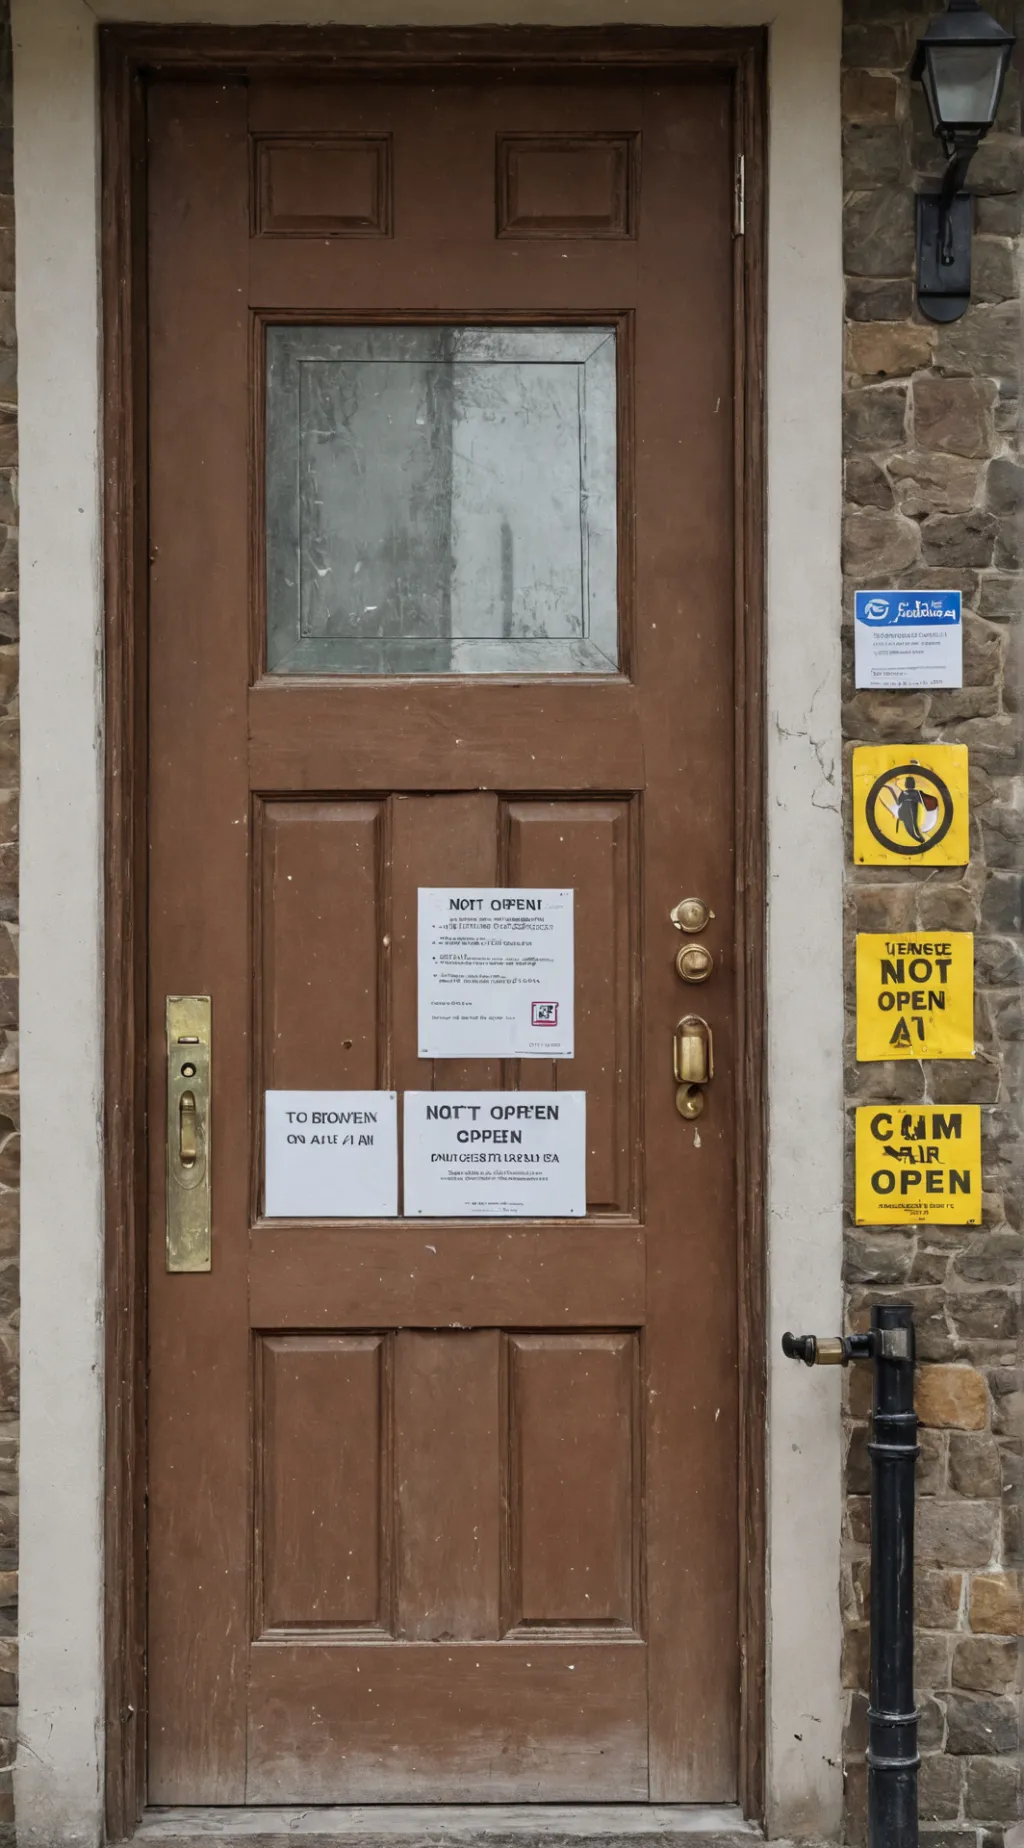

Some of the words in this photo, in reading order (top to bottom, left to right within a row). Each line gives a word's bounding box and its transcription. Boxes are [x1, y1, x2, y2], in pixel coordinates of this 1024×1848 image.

[880, 959, 952, 985] NOT
[878, 990, 946, 1012] OPEN
[285, 1111, 308, 1124] TO
[871, 1169, 971, 1195] OPEN
